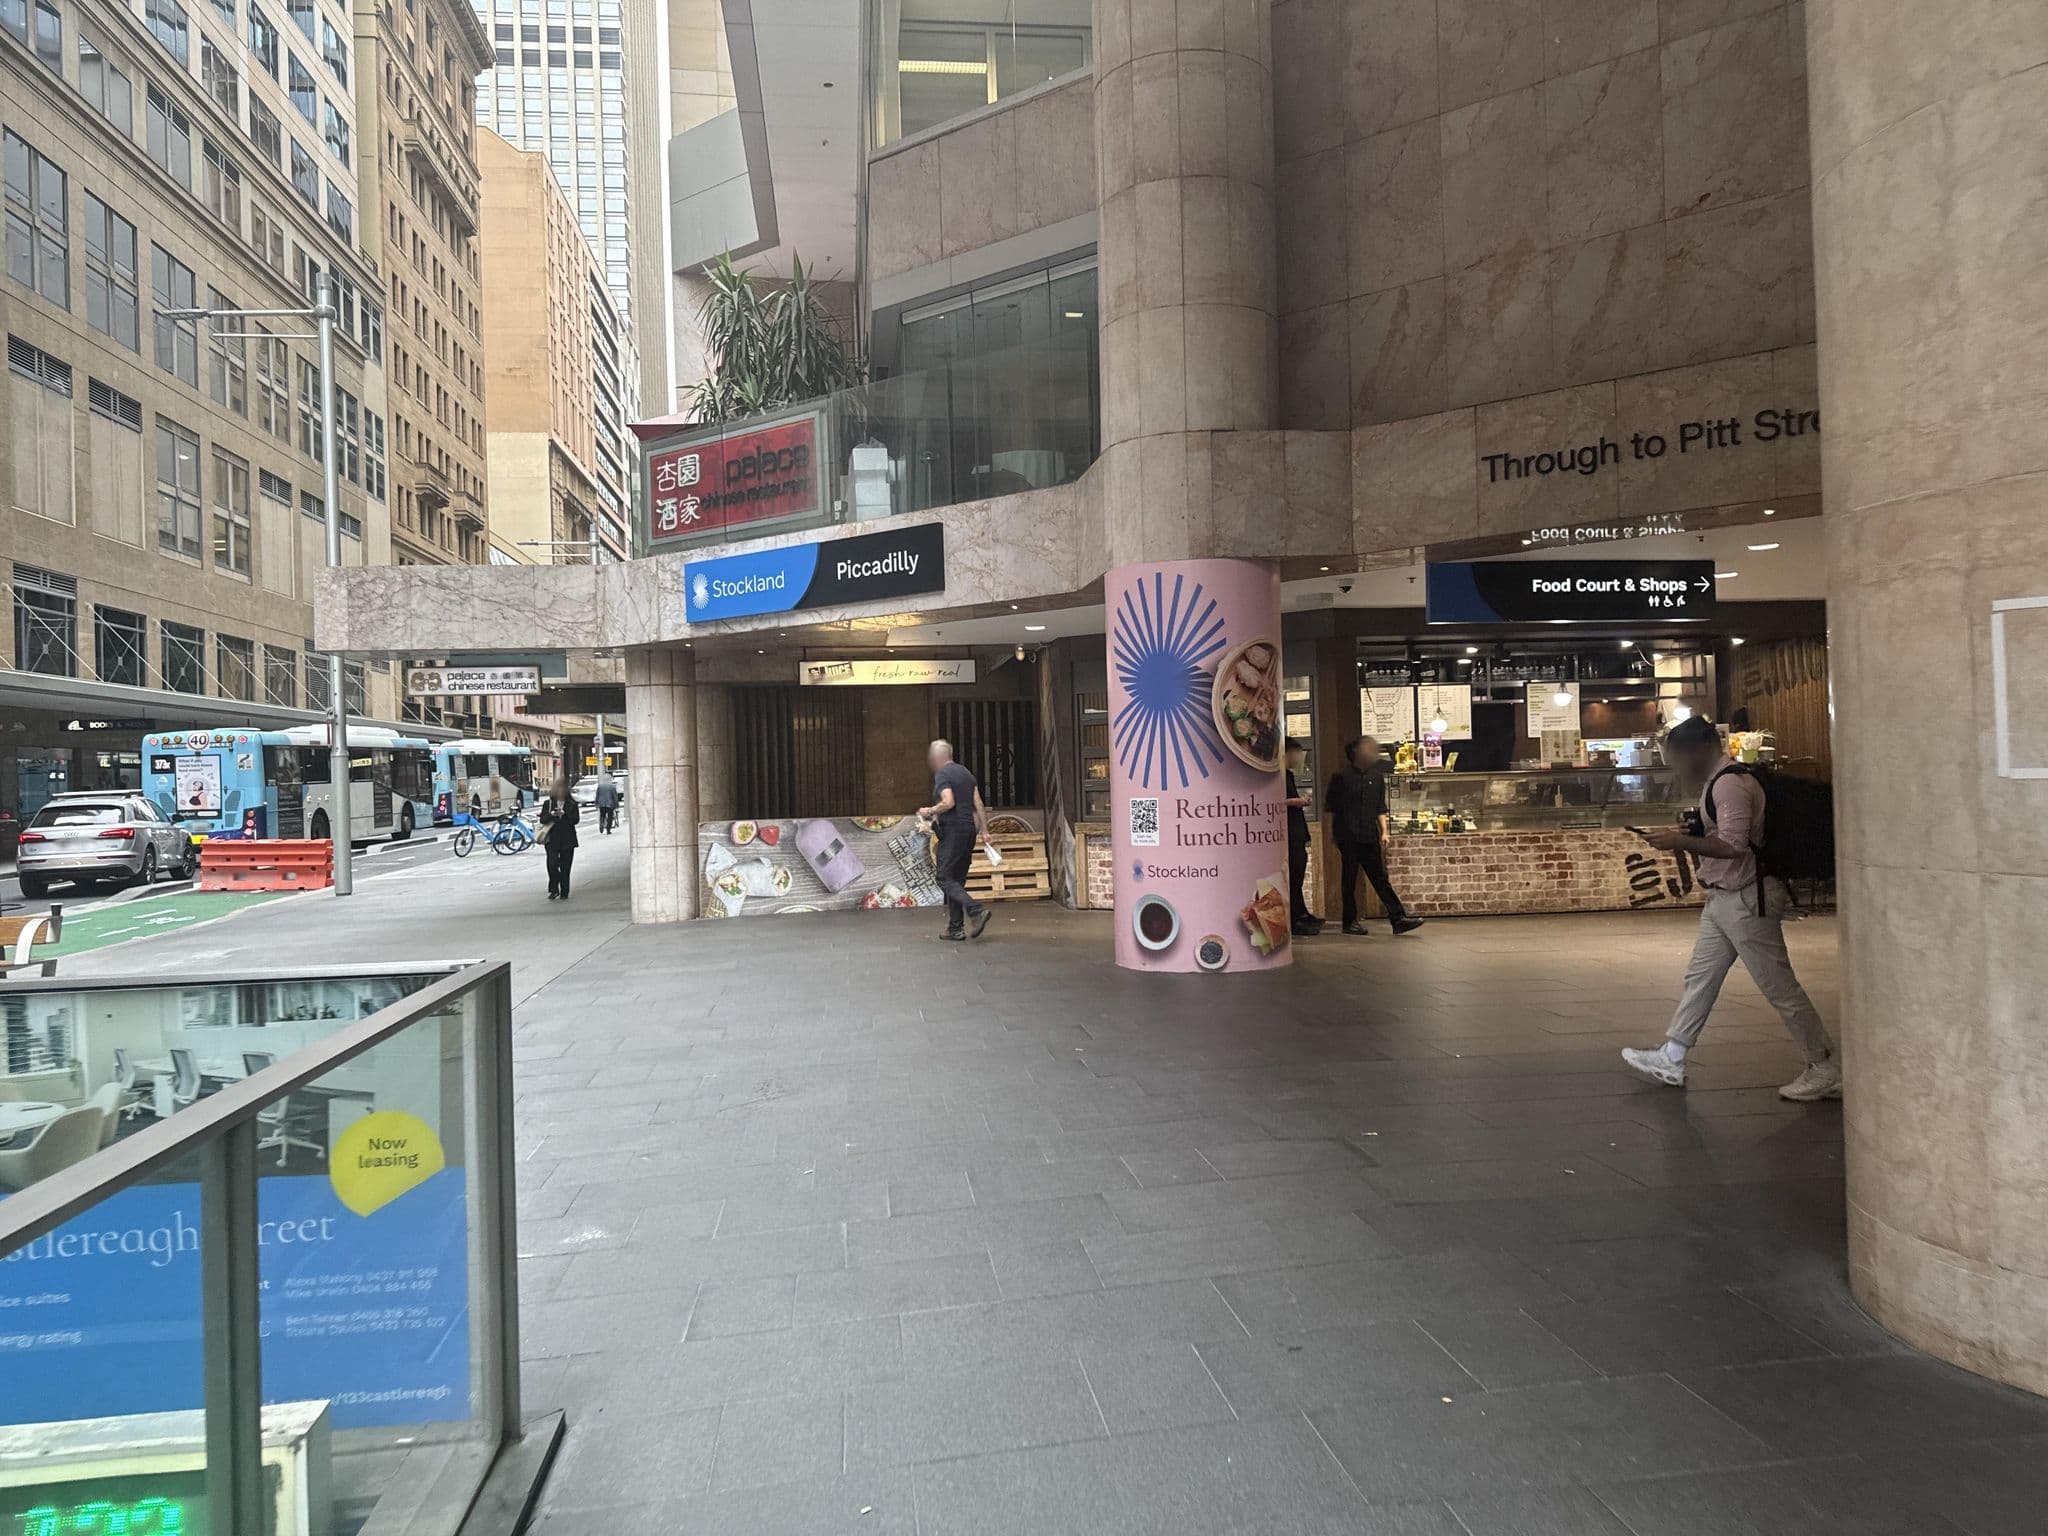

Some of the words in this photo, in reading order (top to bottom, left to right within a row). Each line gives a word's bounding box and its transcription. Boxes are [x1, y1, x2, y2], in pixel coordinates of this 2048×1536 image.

[1481, 436, 1620, 483] Through
[1630, 432, 1666, 459] to
[1679, 417, 1741, 453] Pitt
[656, 453, 700, 492] 杏園
[726, 443, 810, 488] palace
[655, 493, 701, 531] 酒家
[837, 550, 919, 581] Piccadilly
[712, 571, 785, 598] Stockland
[1532, 578, 1571, 593] Food
[1576, 578, 1620, 592] Court
[1624, 578, 1636, 592] &
[1640, 577, 1688, 594] Shops
[447, 670, 486, 682] palace
[873, 663, 905, 681] fresh
[937, 663, 961, 678] real
[447, 681, 486, 691] chinese
[486, 680, 537, 690] restaurant
[190, 735, 207, 746] 40
[1175, 794, 1262, 819] Rethink
[1175, 822, 1237, 847] lunch
[1147, 864, 1219, 879] Stockland
[368, 1137, 408, 1151] Now
[358, 1152, 419, 1169] leasing
